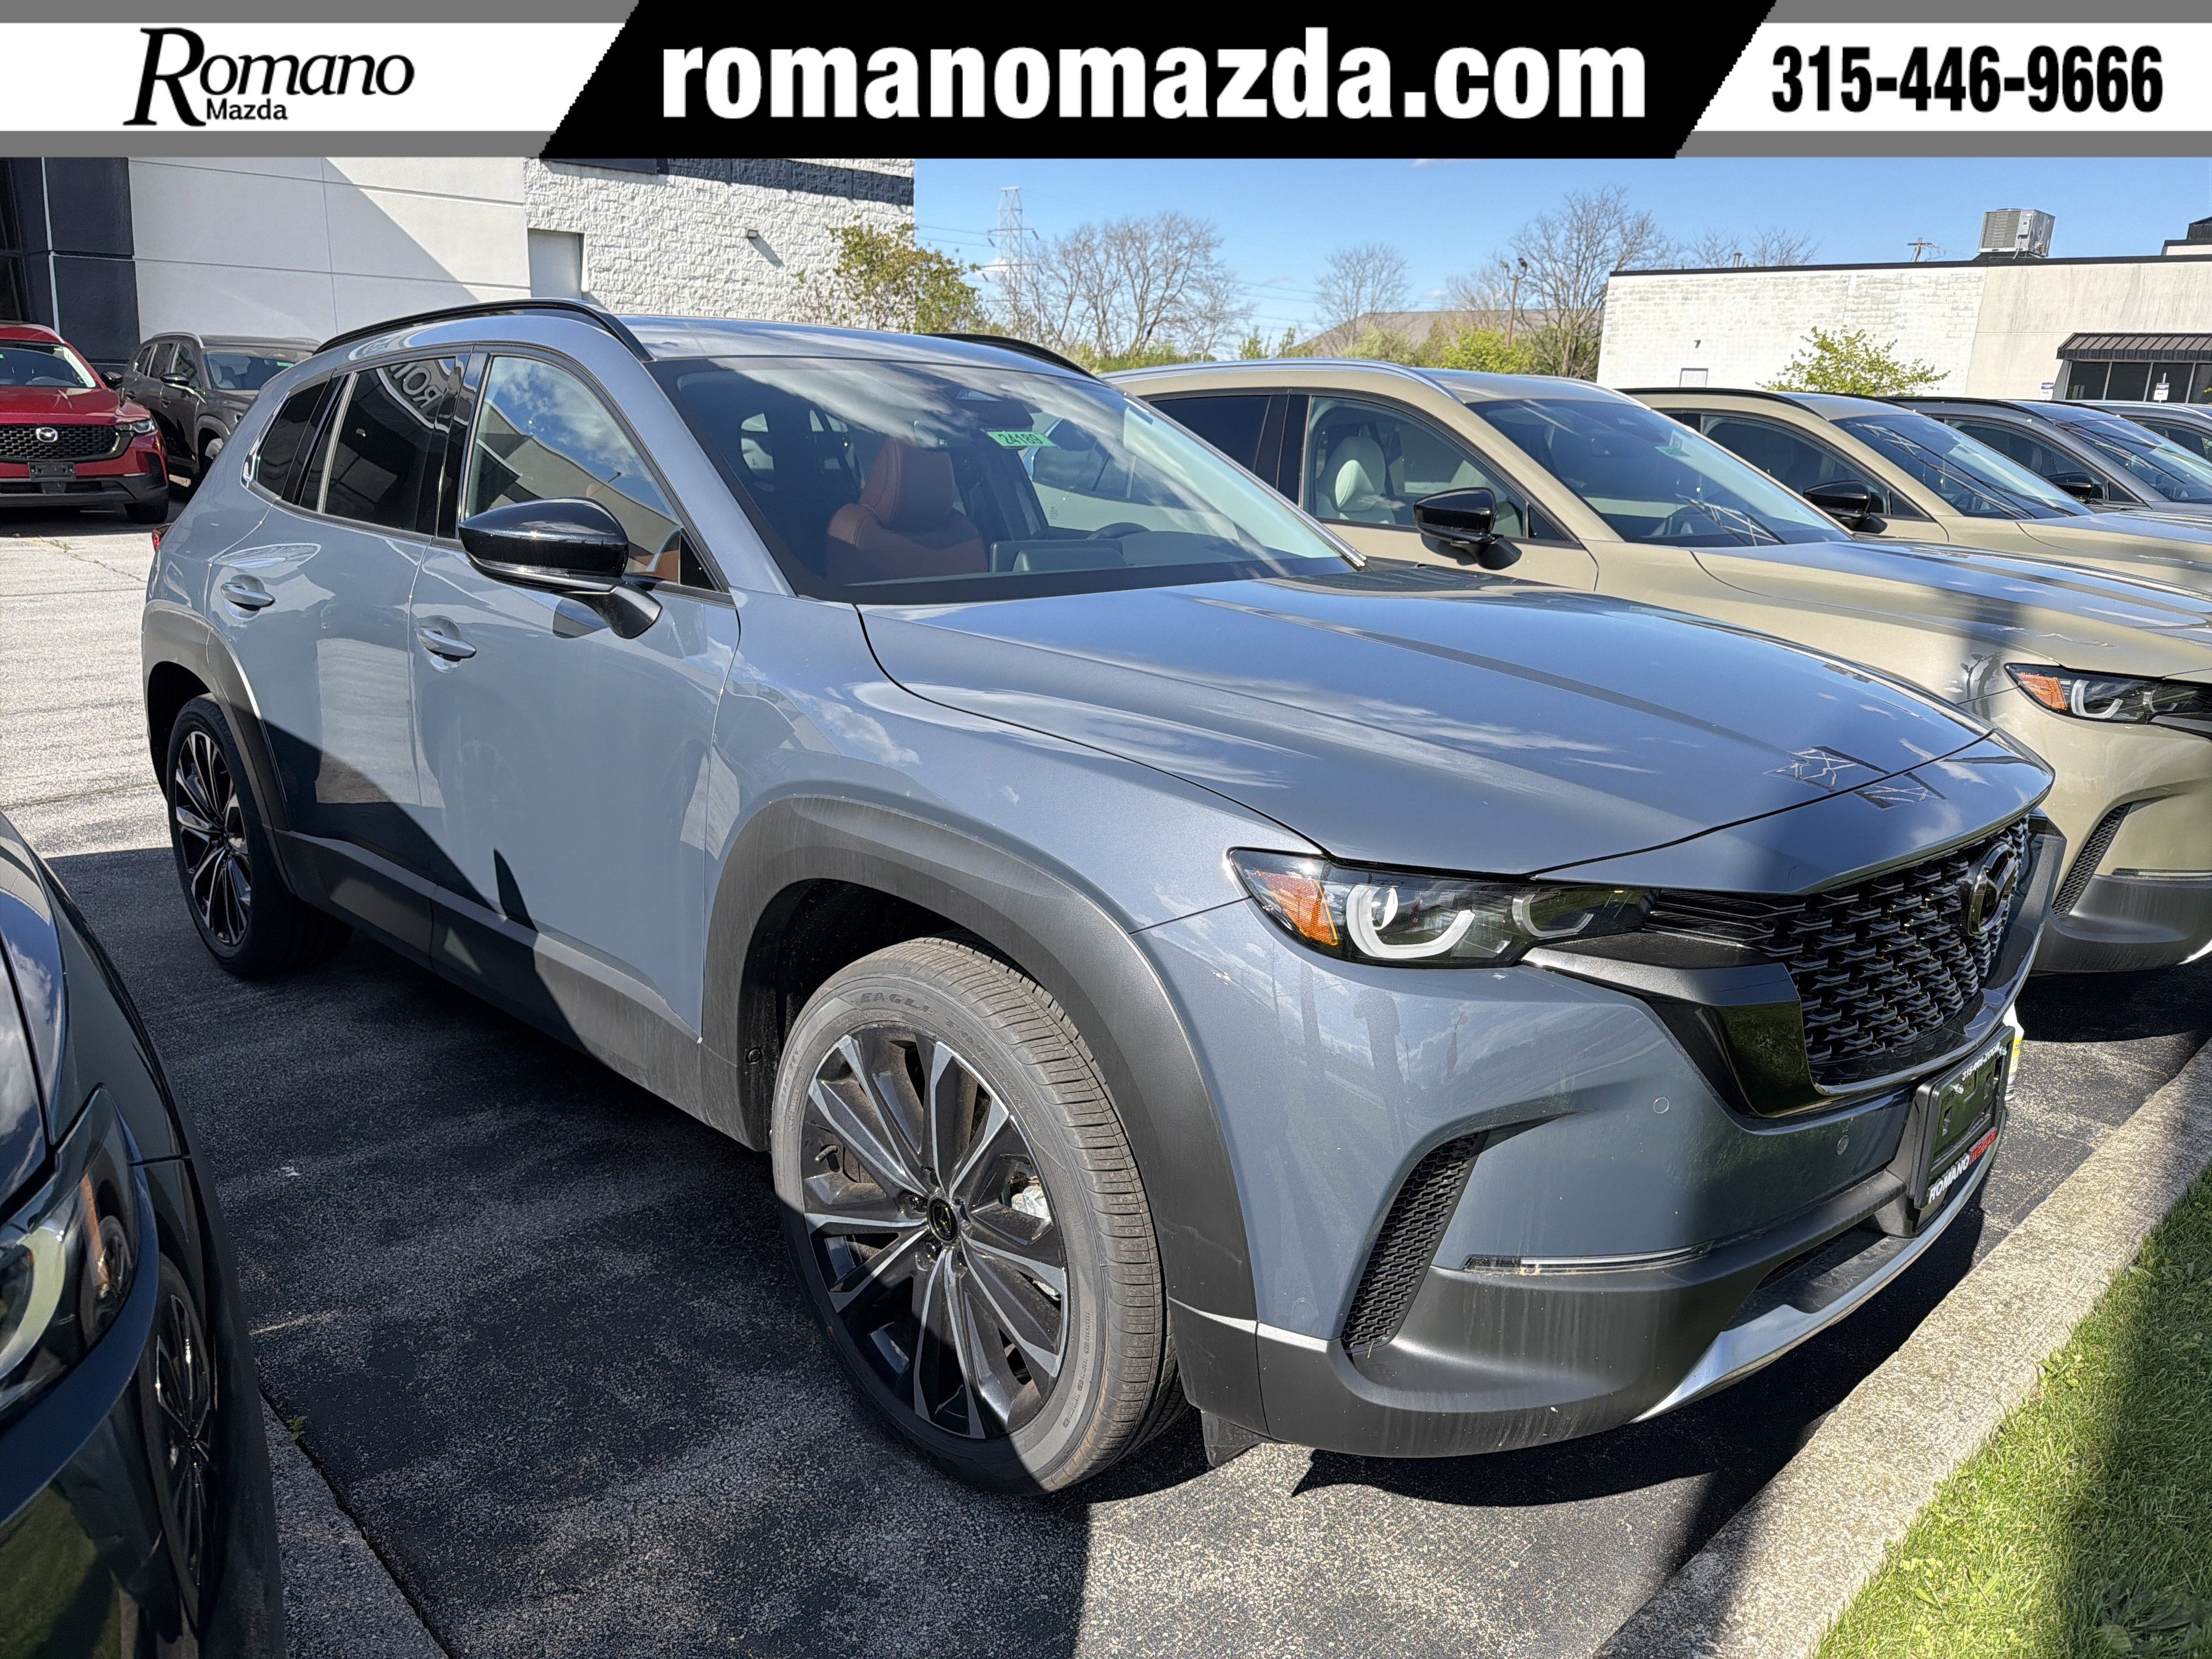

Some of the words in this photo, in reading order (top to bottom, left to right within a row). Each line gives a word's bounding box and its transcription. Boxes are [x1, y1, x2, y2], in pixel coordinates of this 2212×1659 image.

[997, 433, 1043, 445] 24189
[860, 992, 938, 1016] EAGLE
[1928, 1153, 1970, 1204] ROMANO
